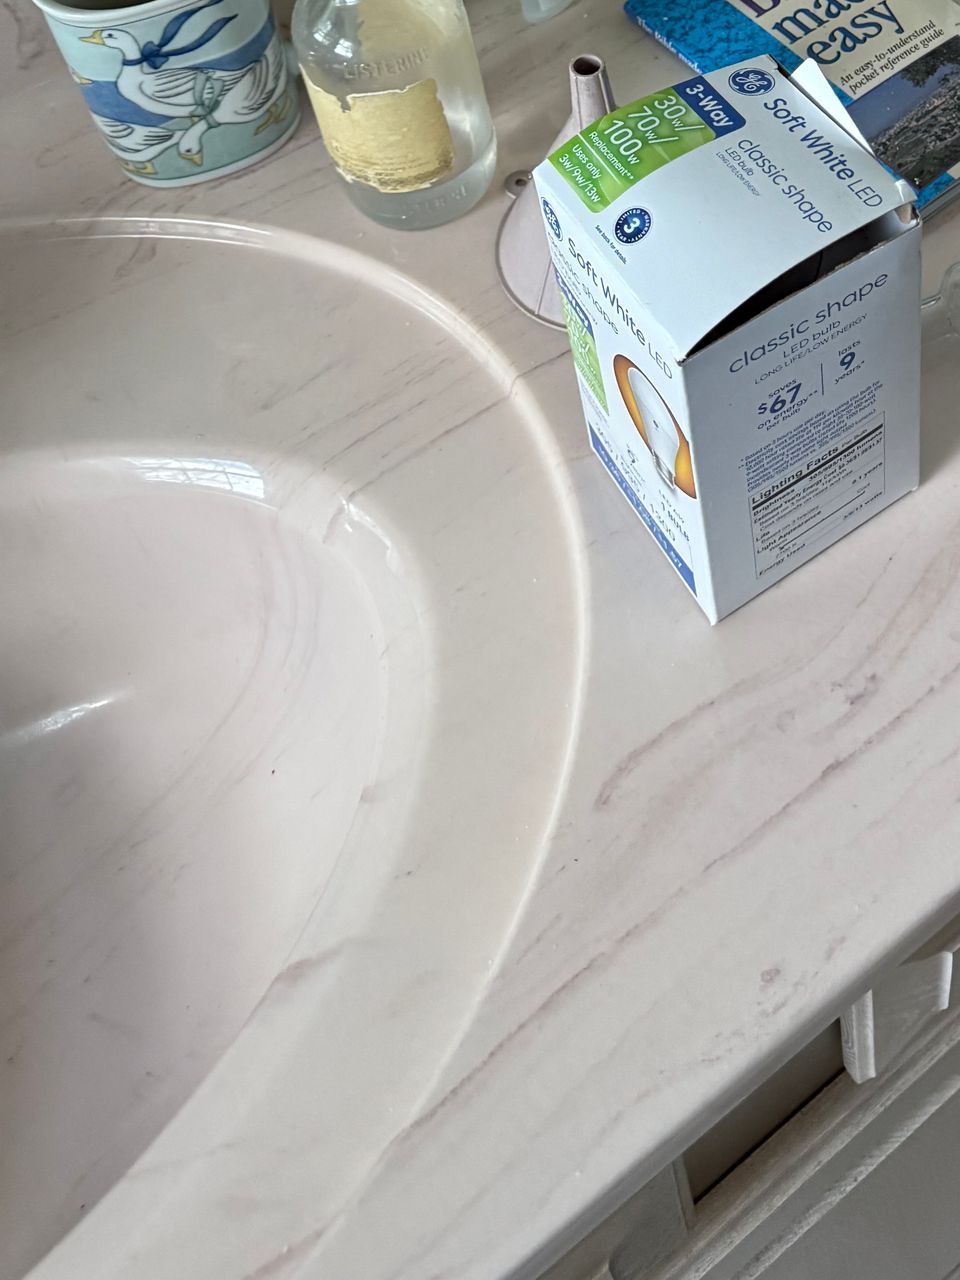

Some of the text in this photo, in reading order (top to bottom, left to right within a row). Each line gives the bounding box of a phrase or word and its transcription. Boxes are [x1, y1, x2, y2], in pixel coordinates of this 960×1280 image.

[806, 0, 905, 65] easy
[840, 20, 937, 87] An easy-to-understand
[848, 29, 945, 95] pocket reference guide
[734, 71, 769, 93] GE
[685, 83, 734, 128] 3-Way
[572, 144, 602, 180] Uses only
[725, 147, 754, 177] LED bulb
[763, 97, 883, 208] Soft White LED
[738, 139, 833, 233] classic shape
[618, 209, 641, 224] LIMITED
[623, 217, 641, 234] 3
[568, 238, 598, 286] Soft
[600, 276, 645, 346] White
[648, 342, 673, 380] LED
[582, 284, 618, 335] shape
[729, 273, 888, 374] classic shape
[754, 313, 868, 385] LONG LIFE/LOW ENERGY
[783, 320, 841, 359] LED bulb
[838, 339, 861, 357] lasts
[839, 351, 856, 371] 9
[757, 382, 803, 415] $67
[768, 378, 798, 398] saves
[757, 416, 773, 431] on
[766, 406, 801, 432] per bulb
[752, 470, 803, 504] Lighting
[806, 446, 839, 470] Facts
[753, 488, 796, 517] Brightness
